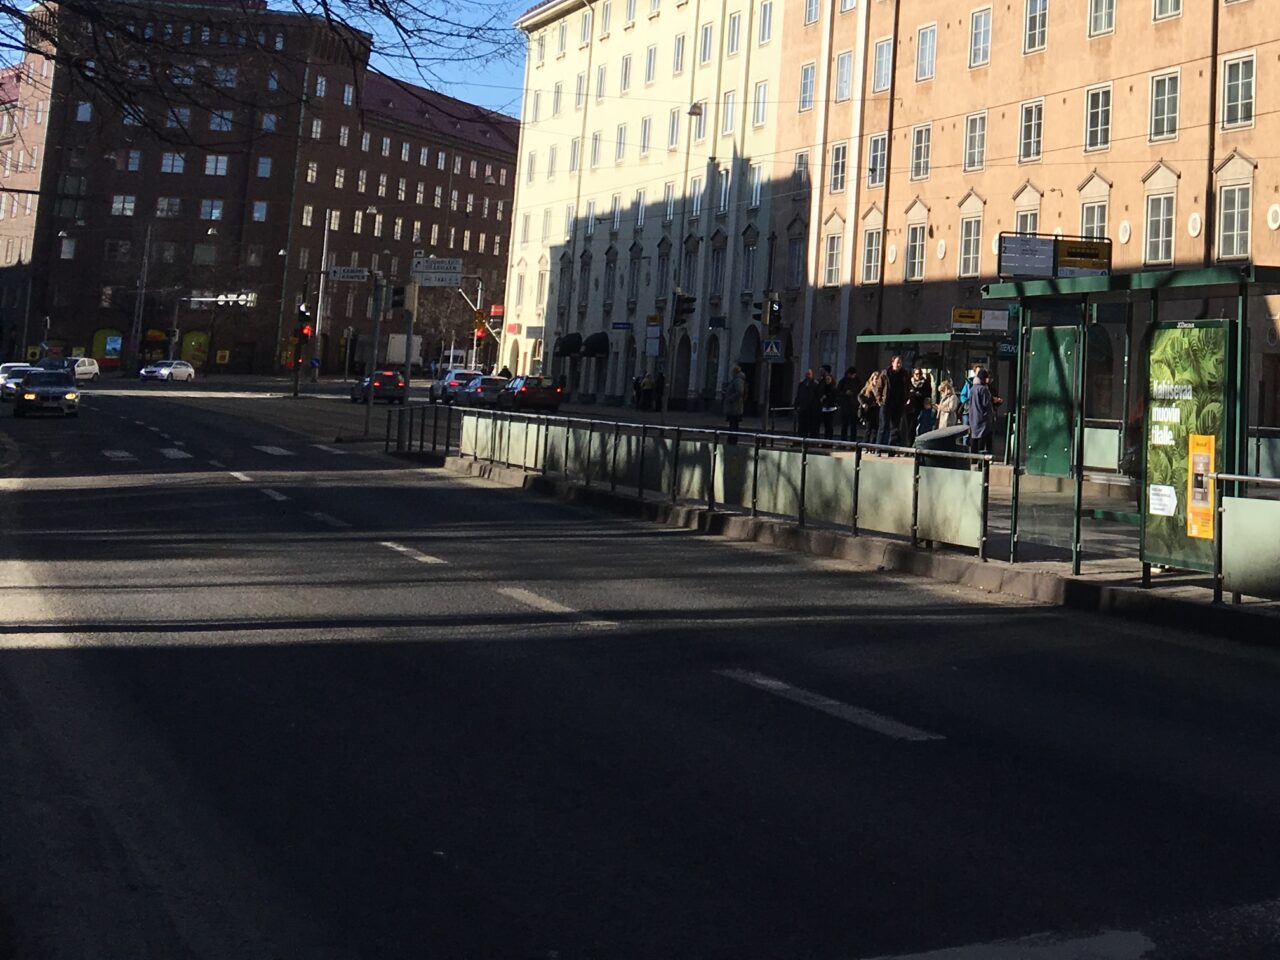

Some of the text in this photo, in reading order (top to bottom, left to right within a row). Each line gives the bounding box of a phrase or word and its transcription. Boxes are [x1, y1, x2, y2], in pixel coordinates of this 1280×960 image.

[1153, 380, 1193, 400] Kahisevaa
[1151, 403, 1181, 423] muovin
[1151, 423, 1176, 446] tilalle.
